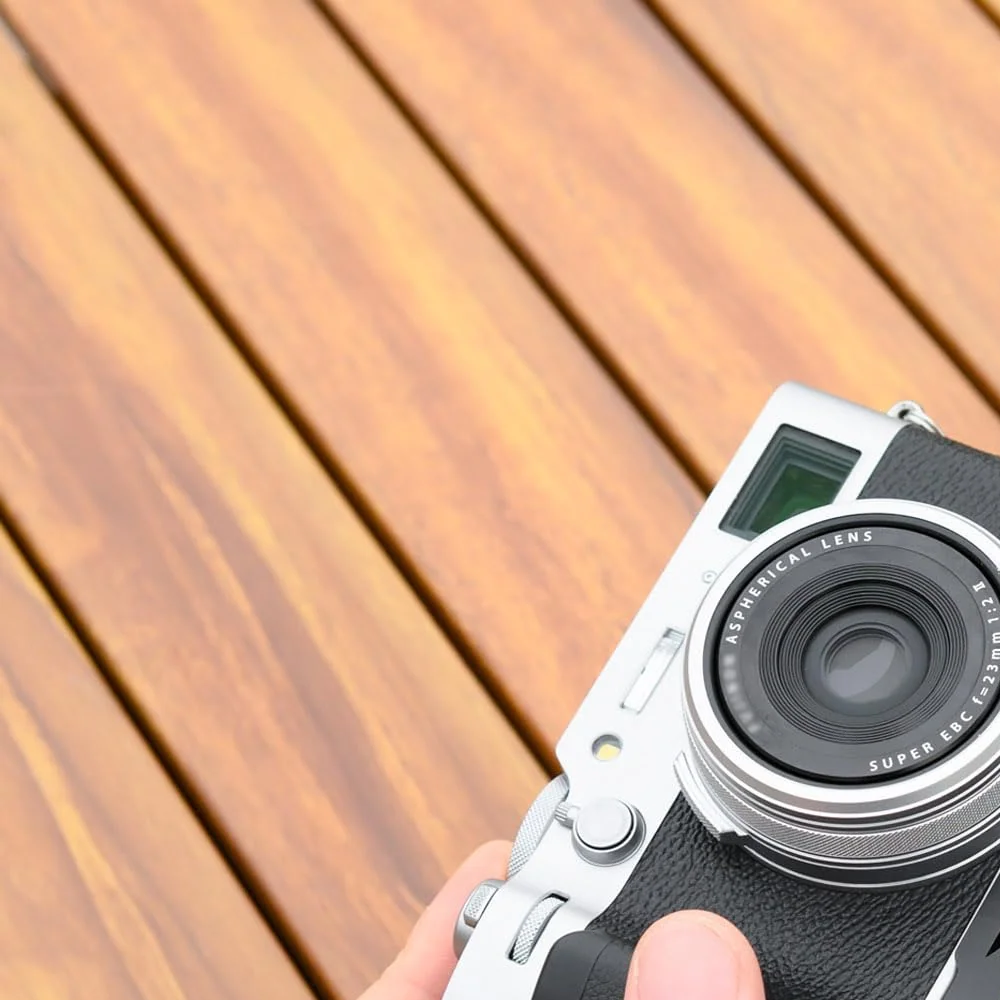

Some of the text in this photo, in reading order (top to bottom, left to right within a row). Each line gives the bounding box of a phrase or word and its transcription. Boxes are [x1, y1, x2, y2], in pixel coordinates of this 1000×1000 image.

[725, 530, 874, 645] ASPHERICAL LENS
[869, 741, 935, 772] SUPER
[940, 711, 973, 741] EBC
[981, 596, 1000, 625] 1:2
